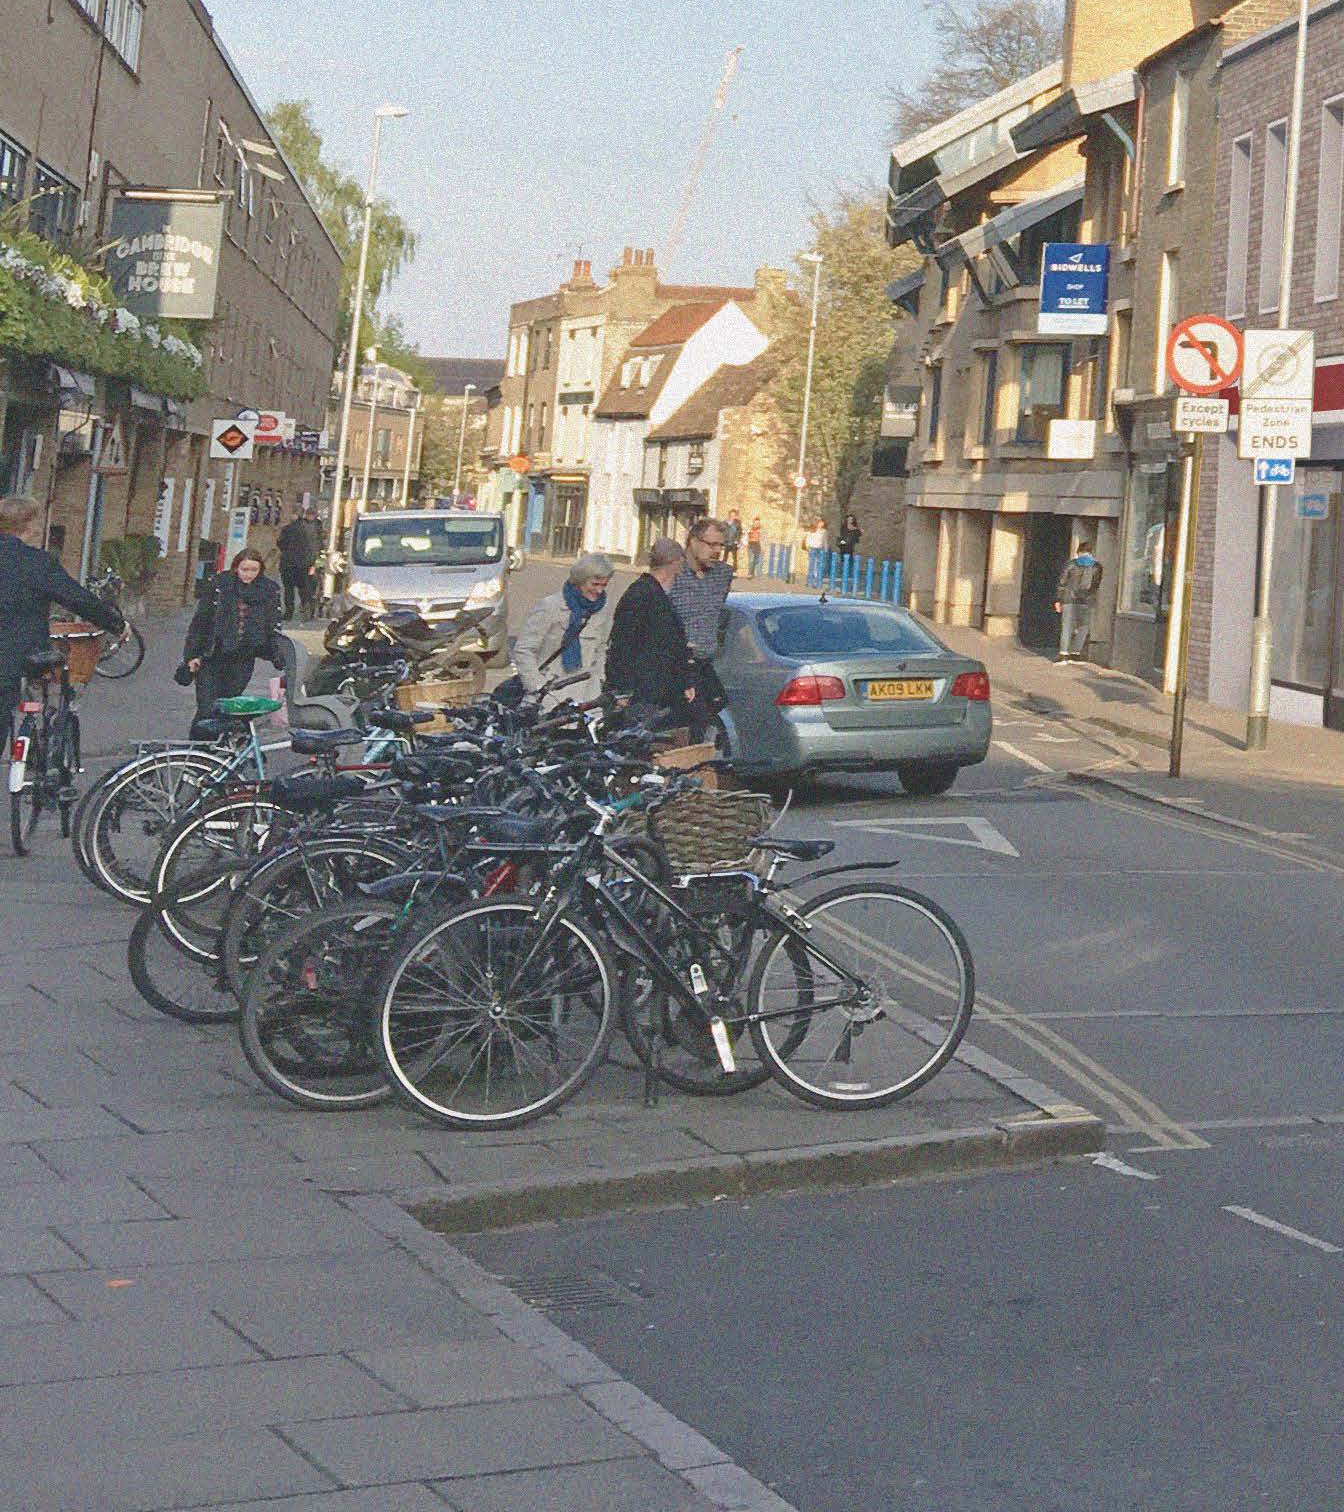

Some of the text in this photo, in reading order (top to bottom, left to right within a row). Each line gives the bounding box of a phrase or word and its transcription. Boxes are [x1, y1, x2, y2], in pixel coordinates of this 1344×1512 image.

[1050, 263, 1102, 273] BIDWELLS
[1058, 297, 1090, 305] TO LET
[1182, 402, 1224, 415] Except
[1246, 403, 1307, 414] Pedestrian
[1183, 417, 1219, 428] cycles
[1263, 418, 1290, 427] Zone
[1251, 435, 1298, 449] ENDS
